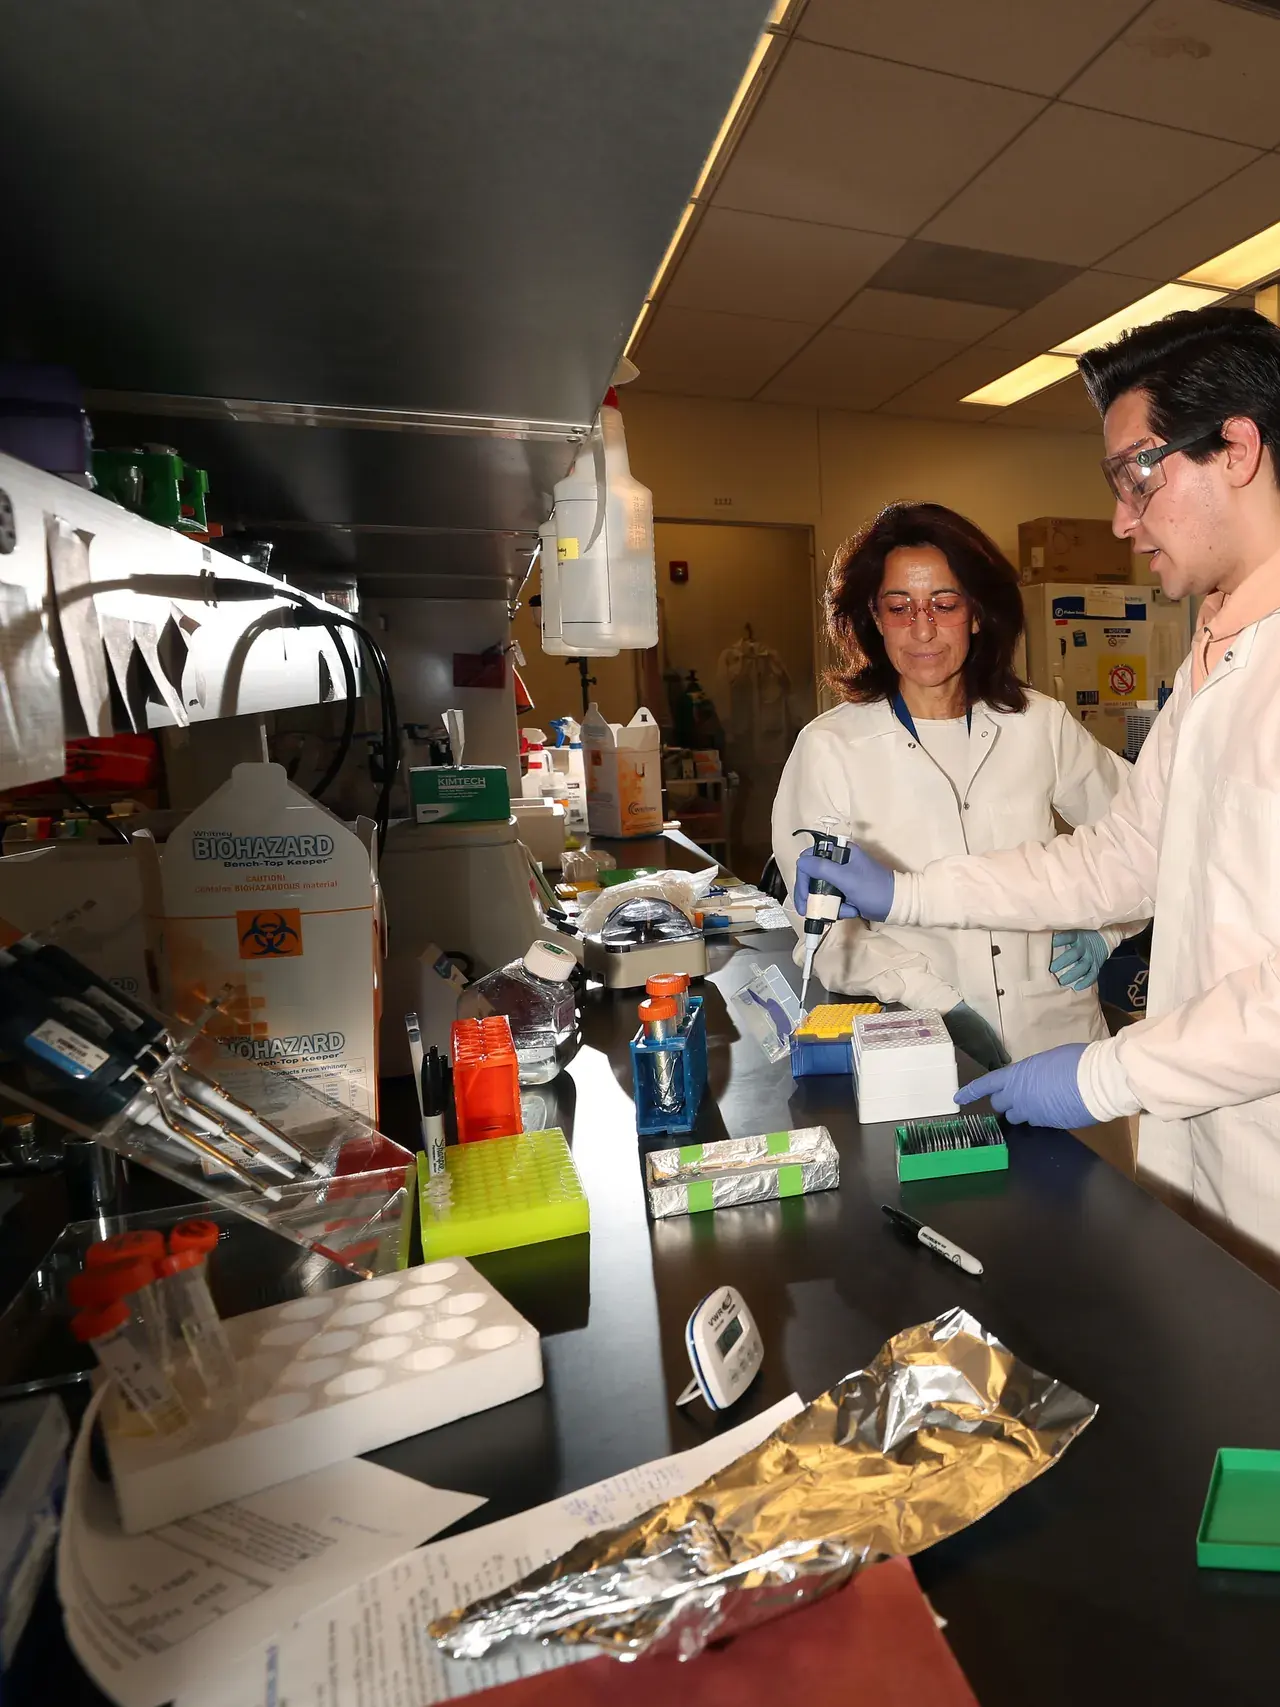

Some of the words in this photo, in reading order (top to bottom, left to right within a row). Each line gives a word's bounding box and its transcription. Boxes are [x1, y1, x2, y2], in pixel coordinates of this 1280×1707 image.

[438, 777, 486, 785] KIMTECH
[193, 830, 233, 838] Whitney
[192, 834, 335, 860] BIOHAZARD
[224, 859, 284, 868] Bench-Top
[245, 874, 286, 882] CAUTION!
[234, 883, 300, 892] BIOHAZARDOUS
[303, 880, 338, 889] material
[257, 1058, 299, 1067] nch-Top
[320, 1063, 348, 1072] Whitney
[434, 1138, 446, 1172] Sharpie
[707, 1308, 724, 1327] VWR
